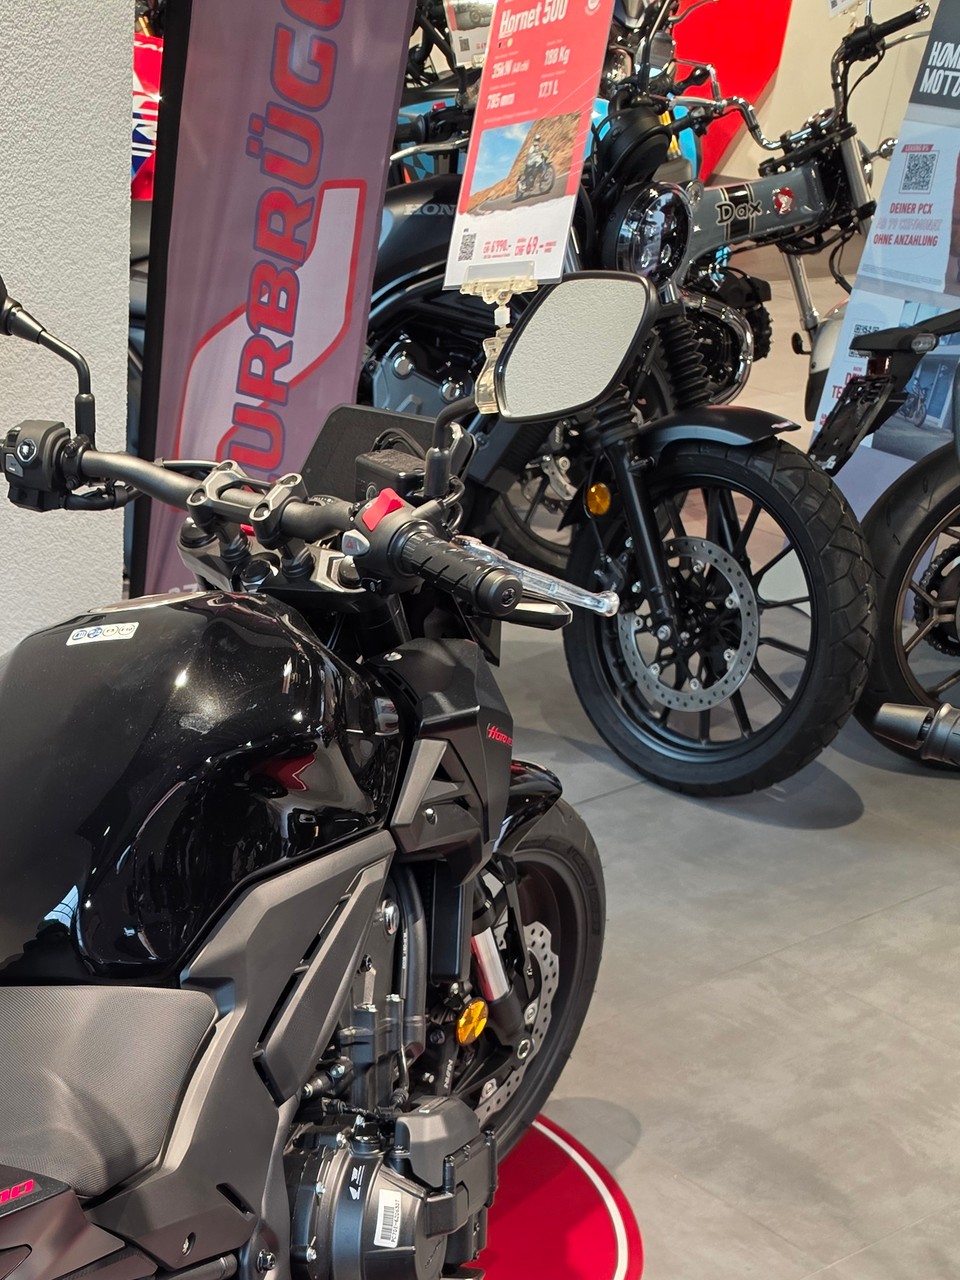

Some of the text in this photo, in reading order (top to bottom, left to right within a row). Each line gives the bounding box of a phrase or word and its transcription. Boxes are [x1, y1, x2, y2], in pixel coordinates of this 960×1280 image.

[499, 0, 569, 35] Hornet 500
[558, 45, 571, 65] Kg
[403, 203, 456, 216] HON
[715, 200, 762, 226] Dax
[889, 202, 934, 214] DEINER PCX
[228, 0, 346, 484] URBRÜG
[873, 234, 939, 247] OHNE ANZAHLUNG
